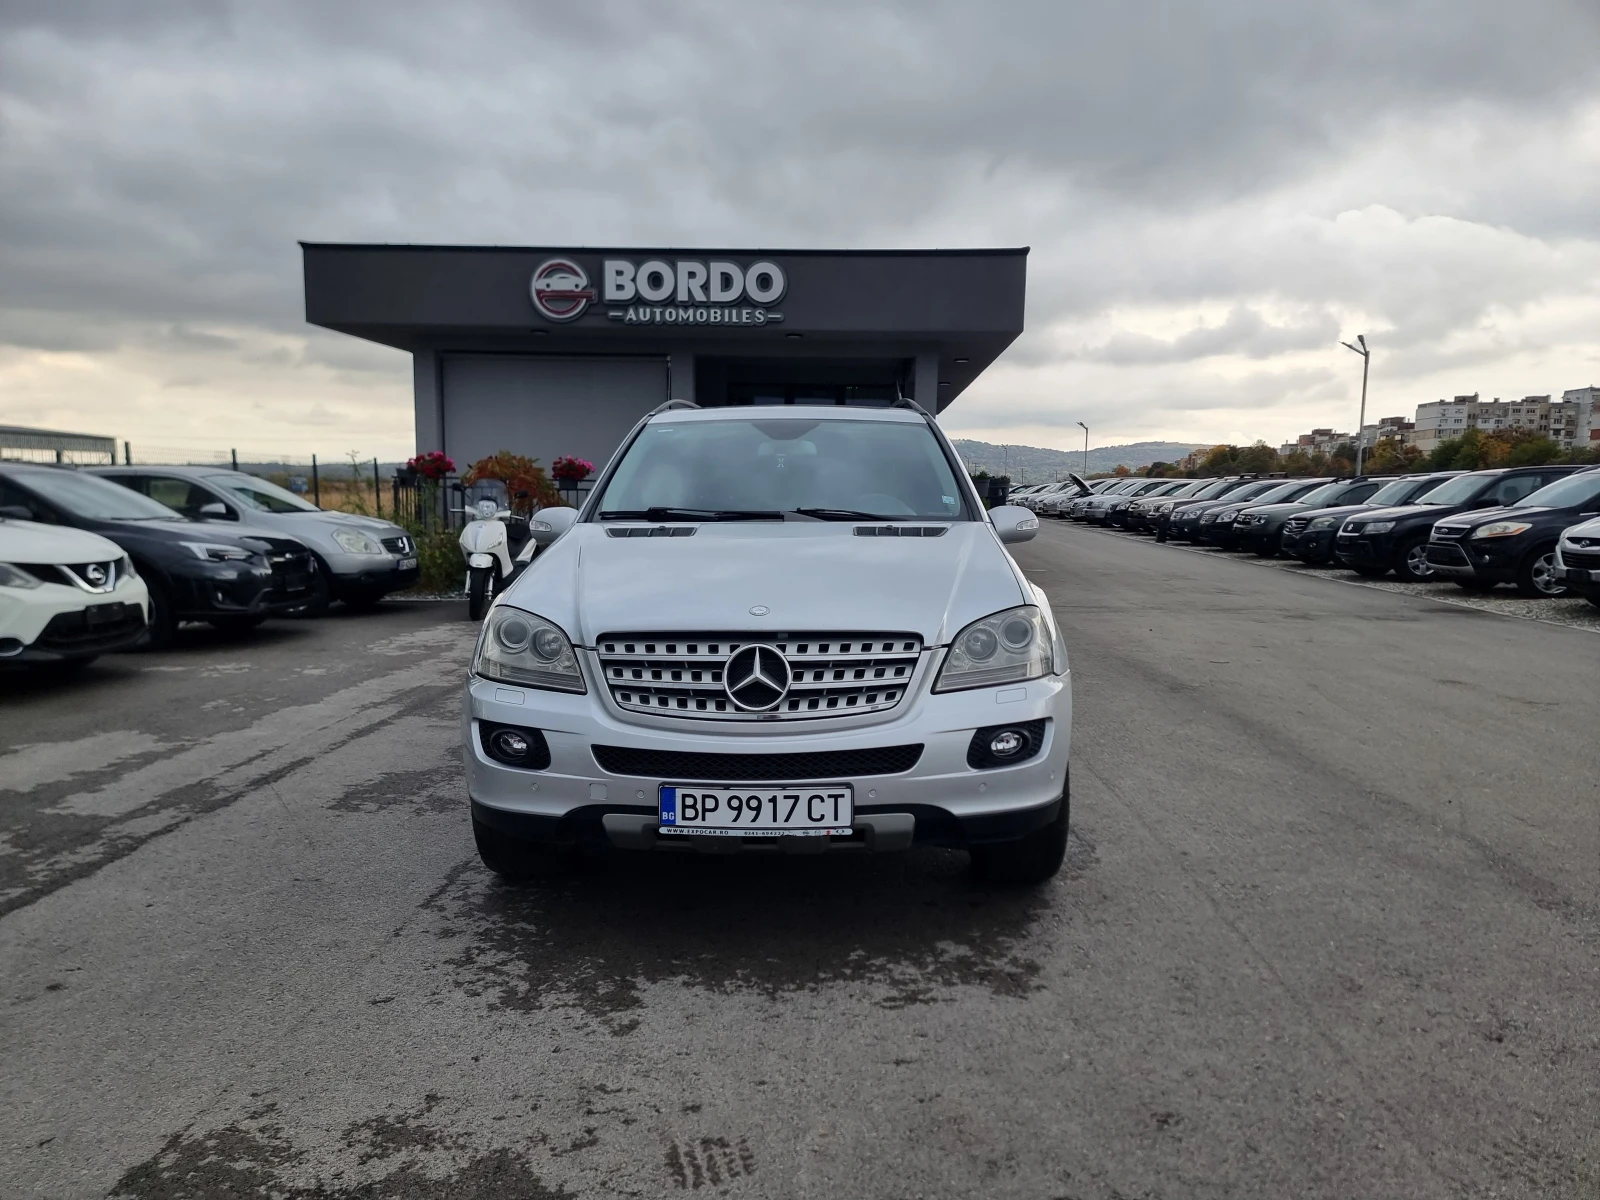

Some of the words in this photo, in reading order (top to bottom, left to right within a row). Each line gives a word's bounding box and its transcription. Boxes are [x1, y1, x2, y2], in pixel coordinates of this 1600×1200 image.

[605, 260, 784, 303] BORDO
[626, 308, 765, 323] AUTOMOBILES
[662, 812, 675, 821] BG
[681, 793, 719, 821] BP
[727, 795, 800, 823] 9917
[807, 793, 845, 822] CT
